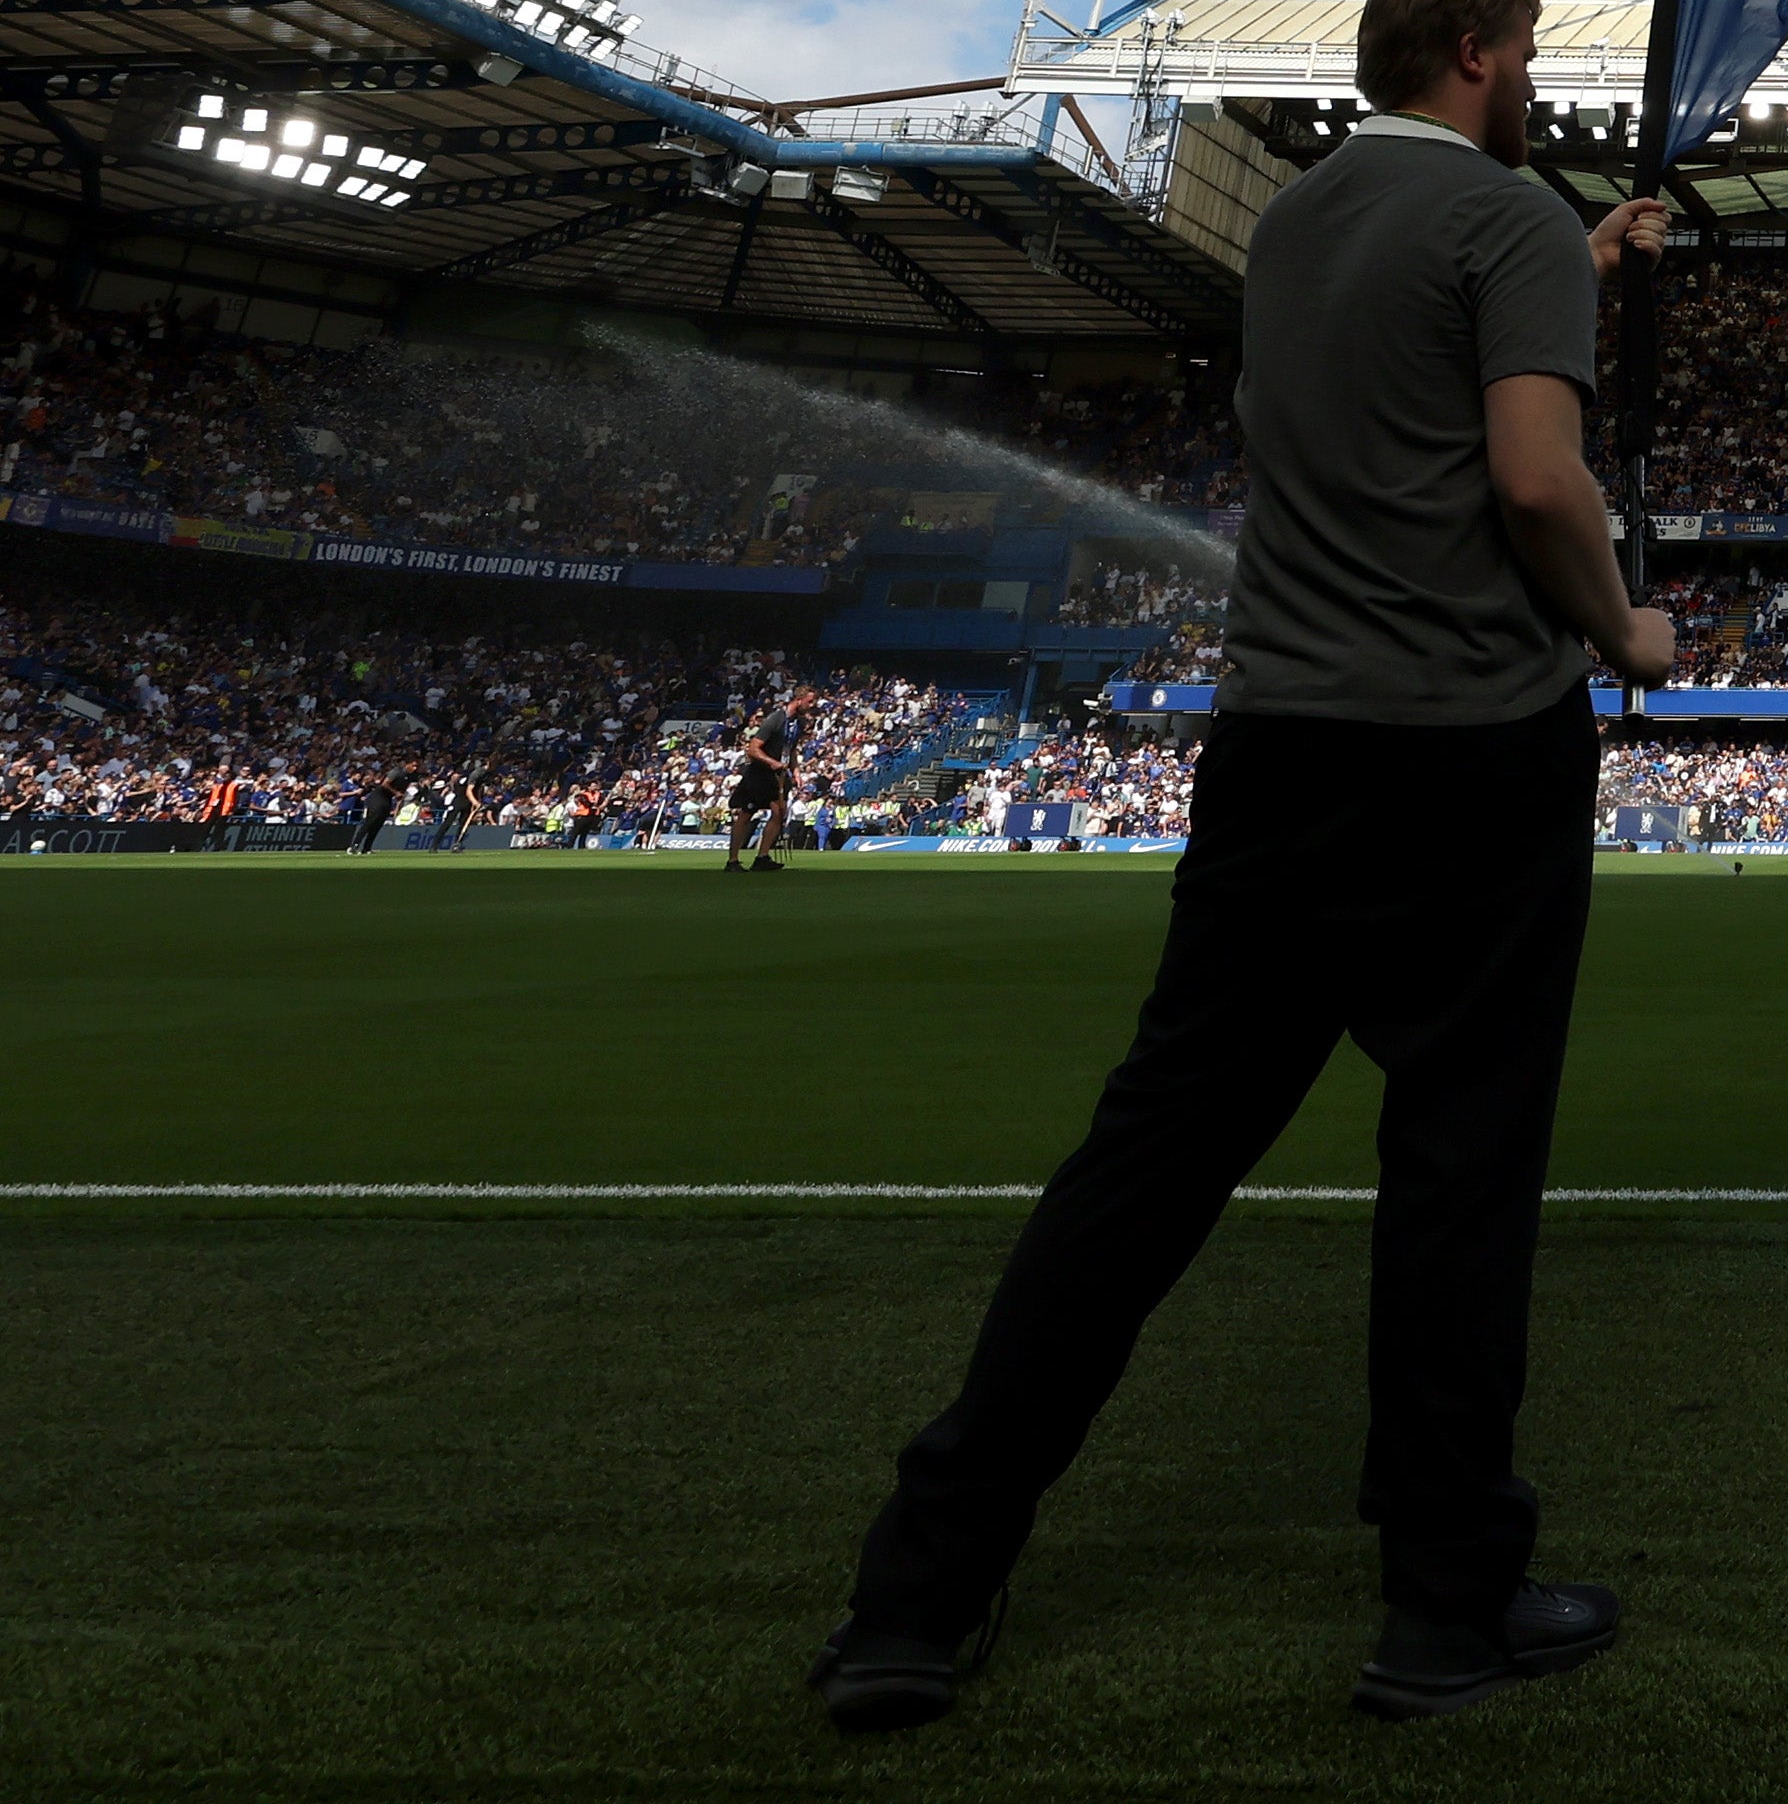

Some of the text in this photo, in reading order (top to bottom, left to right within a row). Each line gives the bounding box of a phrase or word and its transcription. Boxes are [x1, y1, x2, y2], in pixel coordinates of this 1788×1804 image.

[316, 543, 404, 567] LONDON'S
[407, 550, 459, 572] FIRST,
[463, 556, 553, 578] LONDON'S
[558, 563, 624, 583] FINEST
[245, 825, 316, 842] INFINITE
